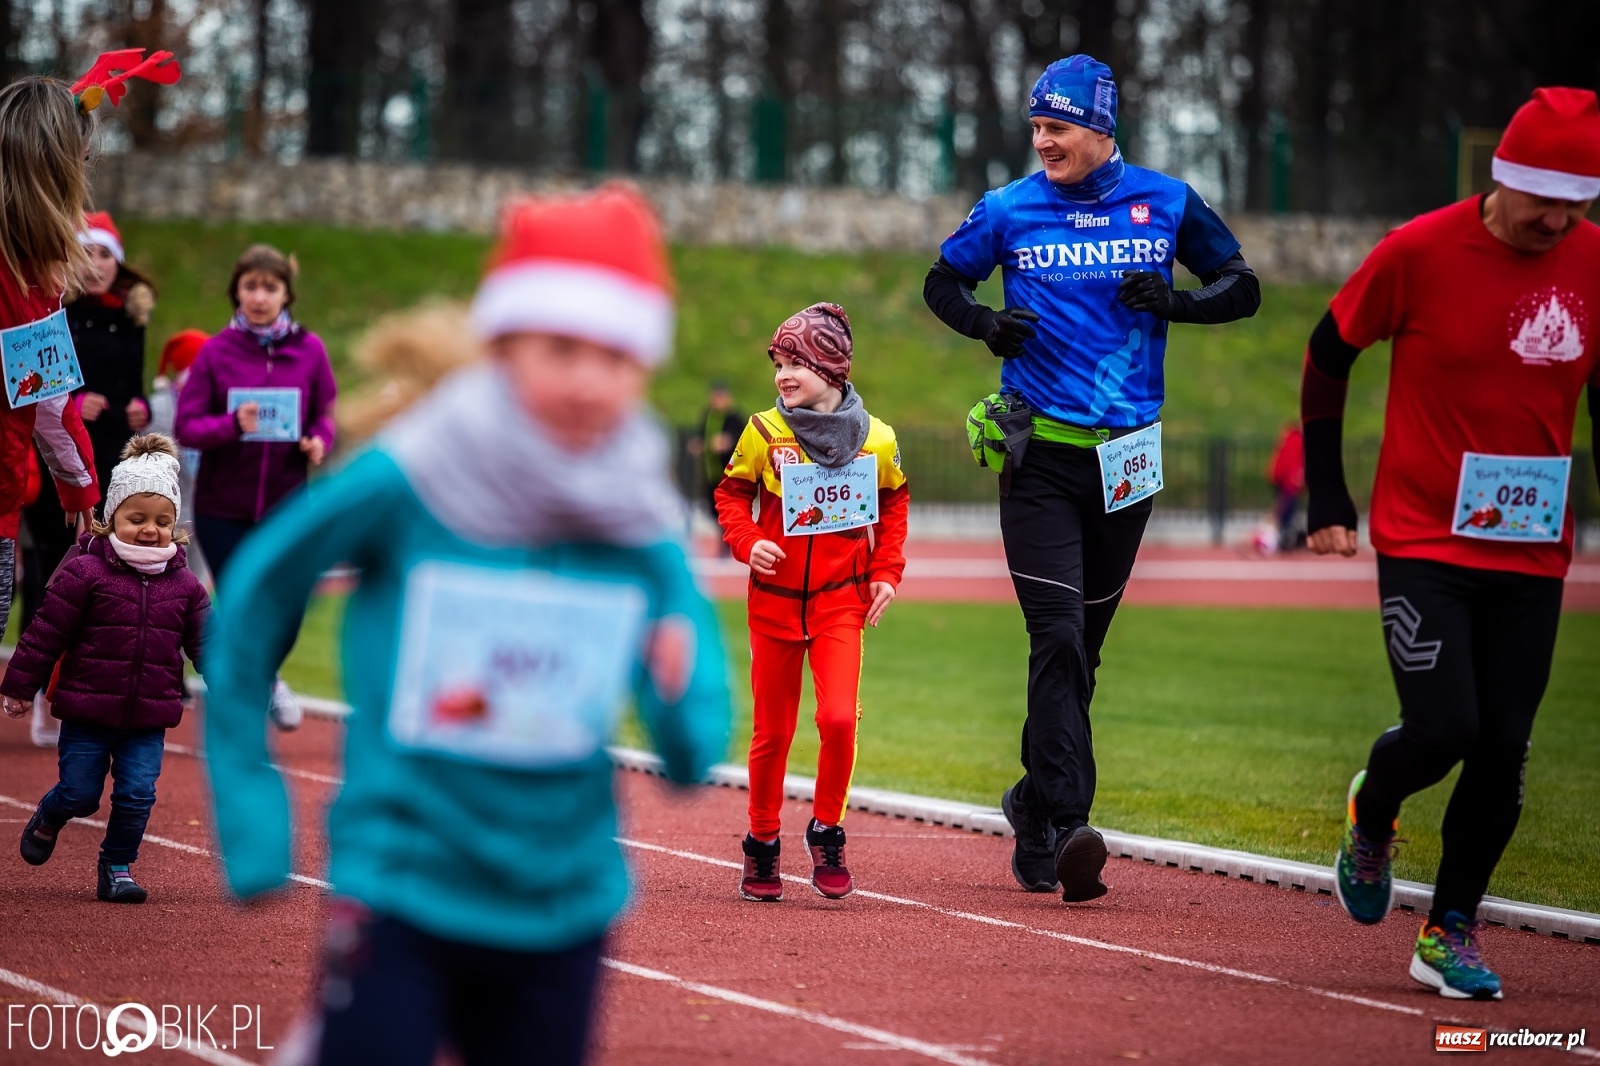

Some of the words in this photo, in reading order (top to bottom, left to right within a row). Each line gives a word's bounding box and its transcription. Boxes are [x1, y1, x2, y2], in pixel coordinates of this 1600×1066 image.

[1013, 238, 1170, 270] RUNNERS
[37, 344, 60, 369] 171
[1123, 452, 1147, 477] 058
[813, 484, 851, 504] 056
[1496, 484, 1538, 507] 026
